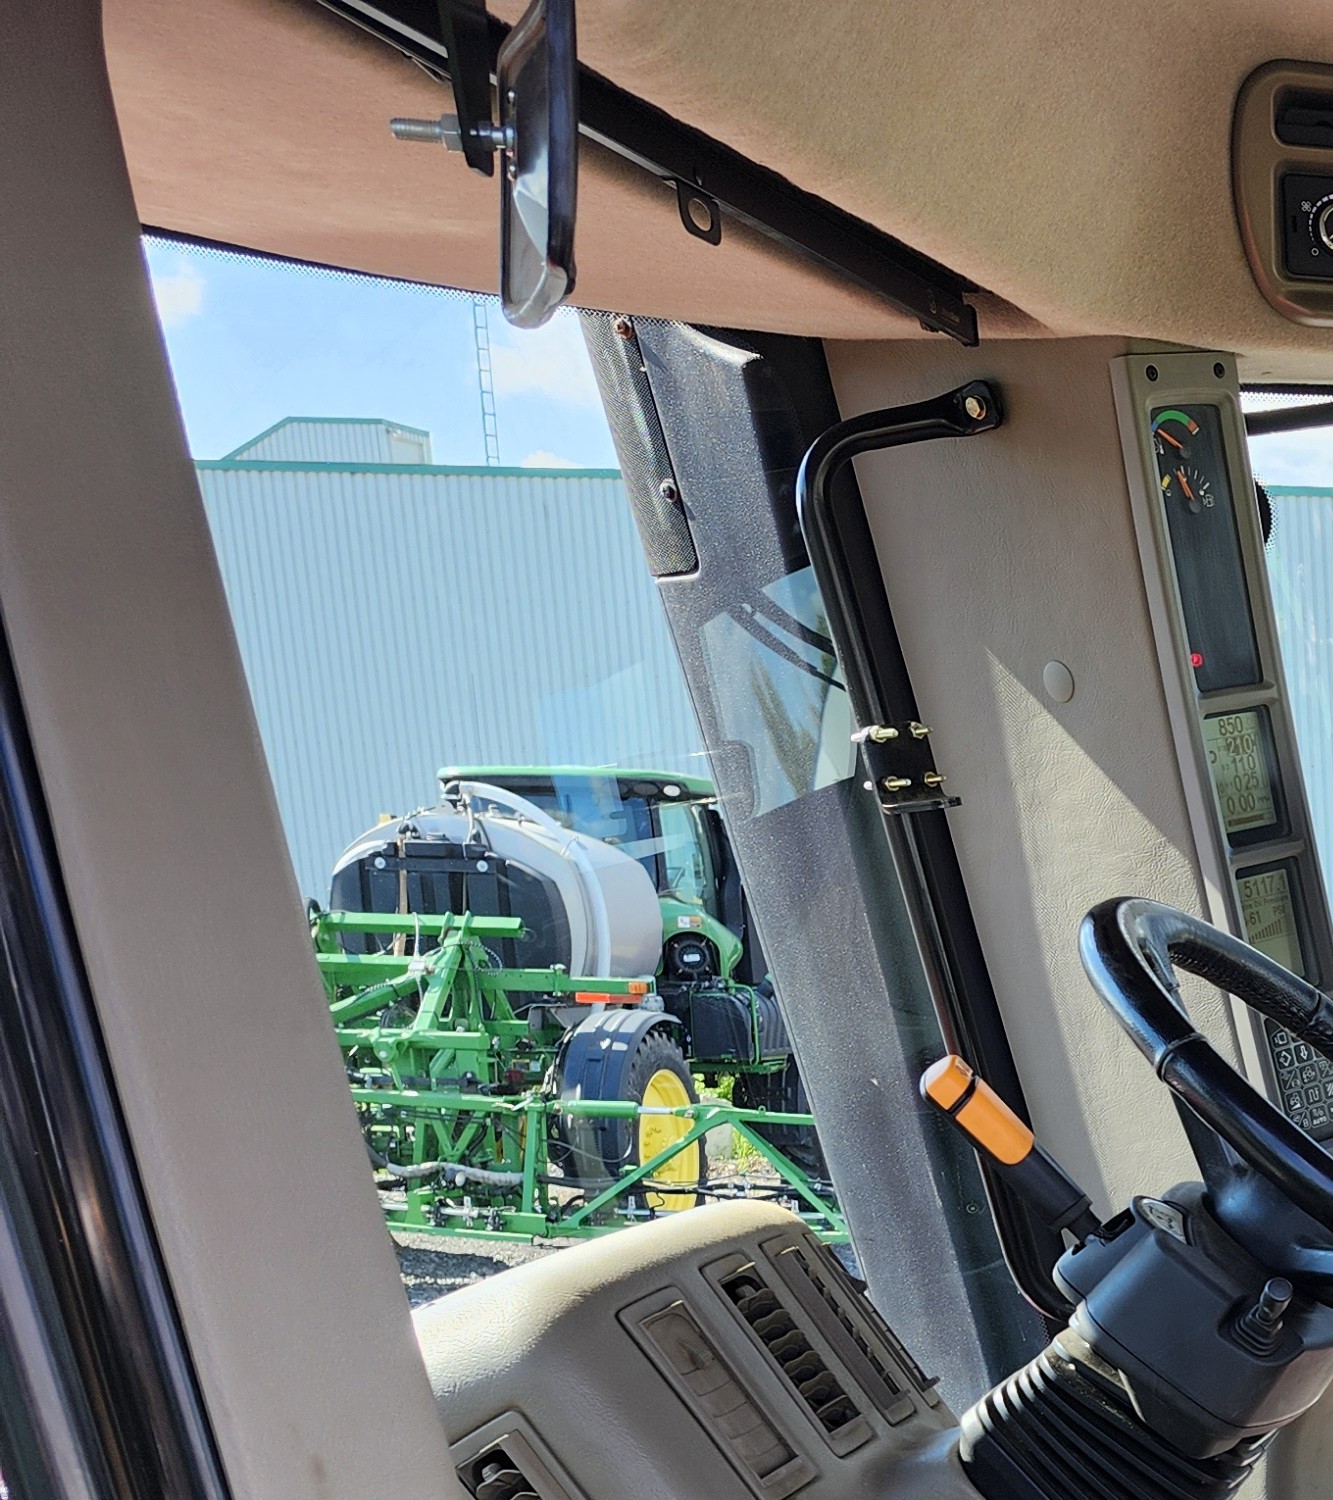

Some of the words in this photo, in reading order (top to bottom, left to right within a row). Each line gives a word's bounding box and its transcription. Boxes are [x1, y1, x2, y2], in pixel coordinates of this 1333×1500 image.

[1218, 715, 1244, 737] 850
[1244, 871, 1286, 898] 5117.1
[1313, 1116, 1327, 1125] AUTO
